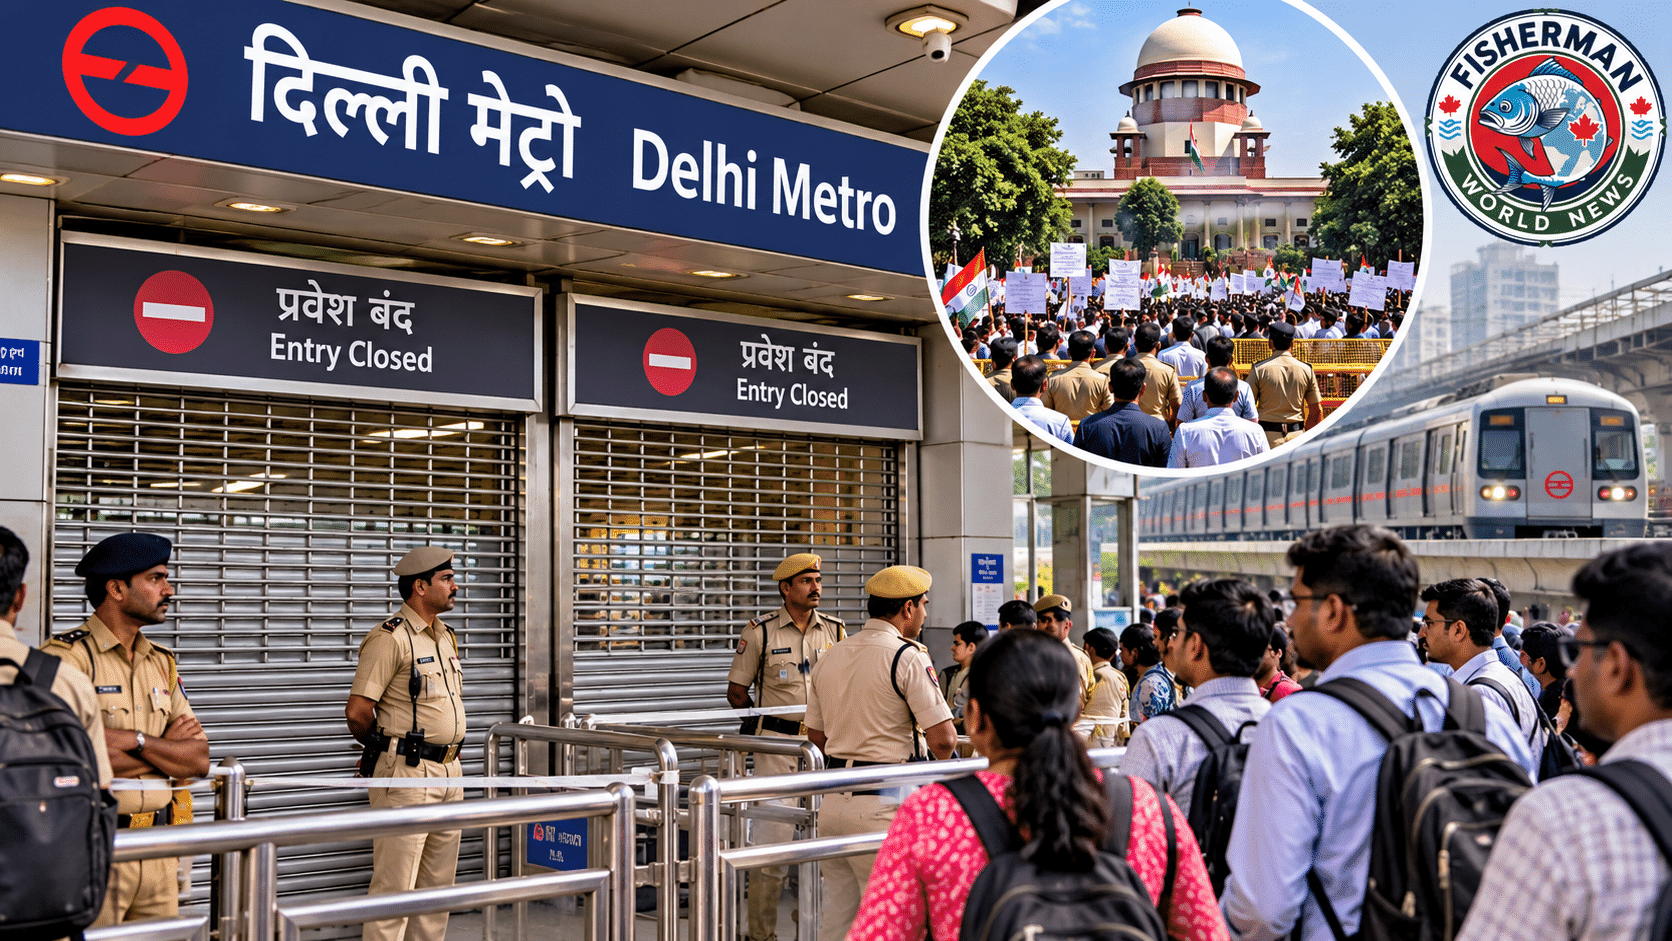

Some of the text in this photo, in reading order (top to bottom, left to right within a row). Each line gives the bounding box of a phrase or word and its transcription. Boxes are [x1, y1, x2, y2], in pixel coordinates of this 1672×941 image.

[244, 22, 582, 193] दिल्ली मेट्रो
[632, 128, 897, 235] Delhi Metro
[276, 280, 415, 335] प्रवेश बंद
[270, 333, 433, 373] Entry Closed
[740, 334, 835, 378] प्रवेश बंद
[737, 378, 848, 410] Entry Closed
